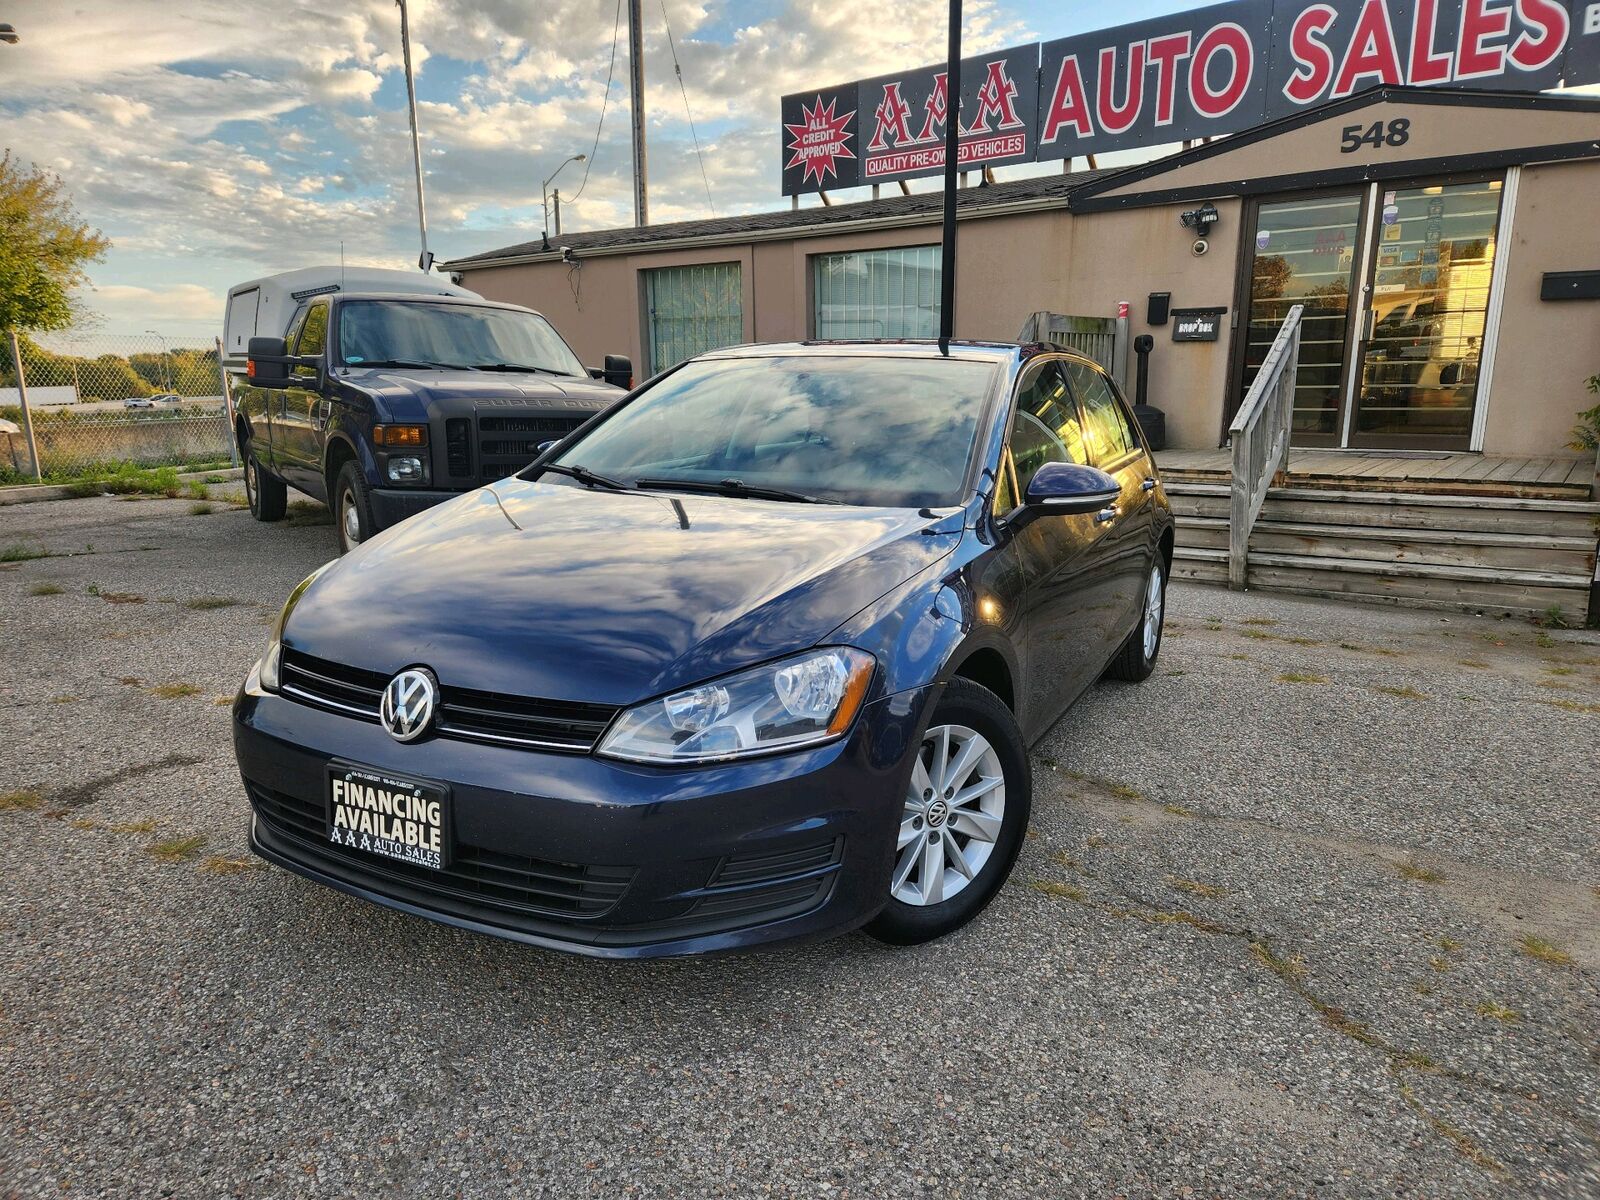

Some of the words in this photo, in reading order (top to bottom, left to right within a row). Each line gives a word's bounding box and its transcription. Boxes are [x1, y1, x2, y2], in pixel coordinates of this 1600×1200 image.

[1039, 22, 1254, 145] AUTO
[1282, 0, 1570, 104] SALES
[802, 129, 836, 144] CREDIT
[809, 117, 829, 131] ALL
[1341, 118, 1410, 153] 548
[798, 141, 841, 160] APPROVED
[868, 153, 909, 174] QUALITY
[971, 137, 1022, 157] VEHICLES
[474, 399, 553, 408] SUPER
[332, 779, 440, 827] FINANCING
[334, 805, 440, 852] AVAILABLE
[374, 838, 402, 853] AUTO
[405, 845, 440, 864] SALES
